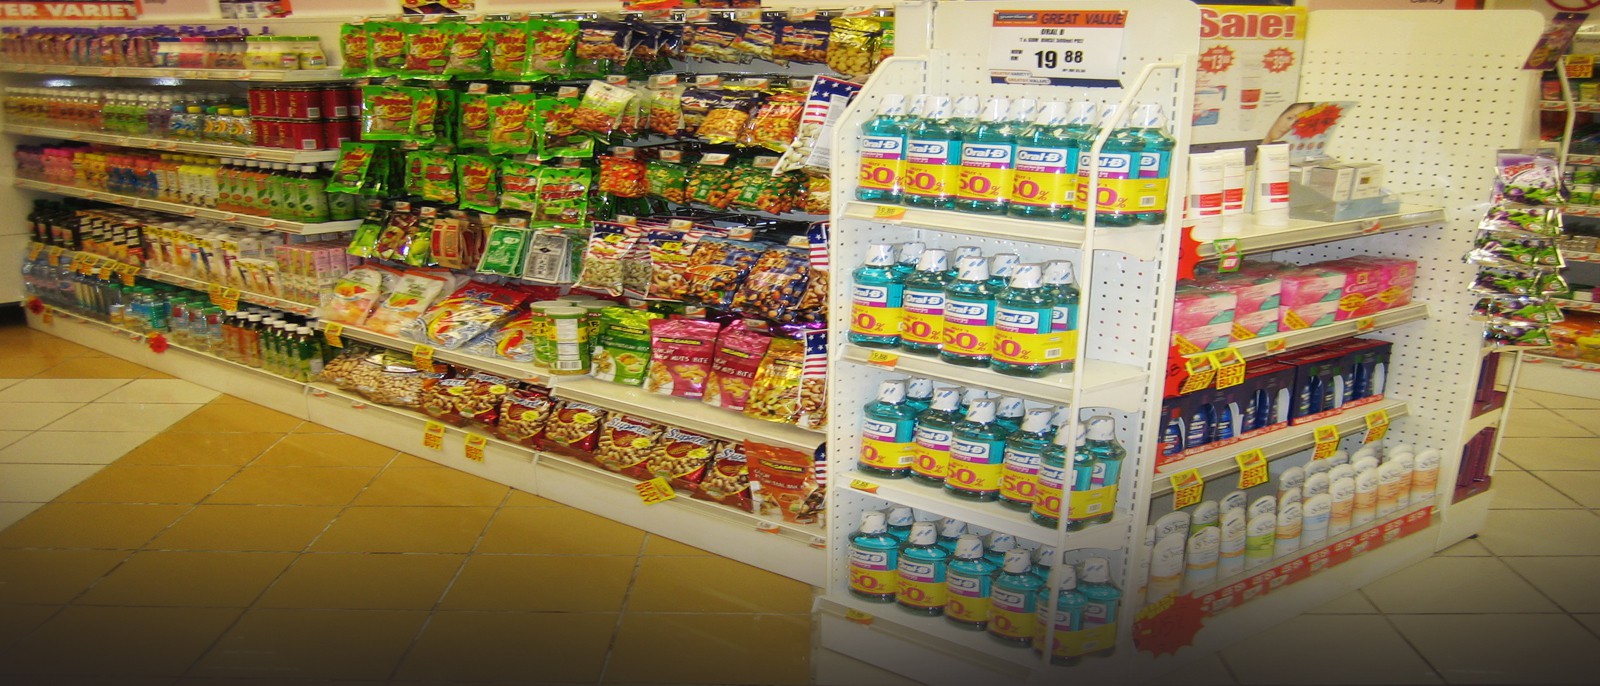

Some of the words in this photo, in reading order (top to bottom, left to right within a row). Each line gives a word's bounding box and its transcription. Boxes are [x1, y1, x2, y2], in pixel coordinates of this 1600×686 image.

[1041, 13, 1081, 25] GREAT
[1085, 13, 1124, 25] VALUE
[1200, 8, 1296, 38] Sale!
[1034, 50, 1058, 69] 19
[1064, 50, 1083, 63] 88
[965, 147, 1006, 158] Oral-B
[1019, 151, 1060, 163] Oral-B
[1189, 370, 1216, 382] BEST
[1220, 364, 1245, 378] BEST
[1219, 376, 1242, 388] BUY
[1317, 441, 1338, 452] BEST
[1243, 465, 1265, 480] BEST
[1242, 475, 1264, 488] BUY
[1176, 484, 1201, 498] BEST
[1175, 495, 1198, 508] BUY
